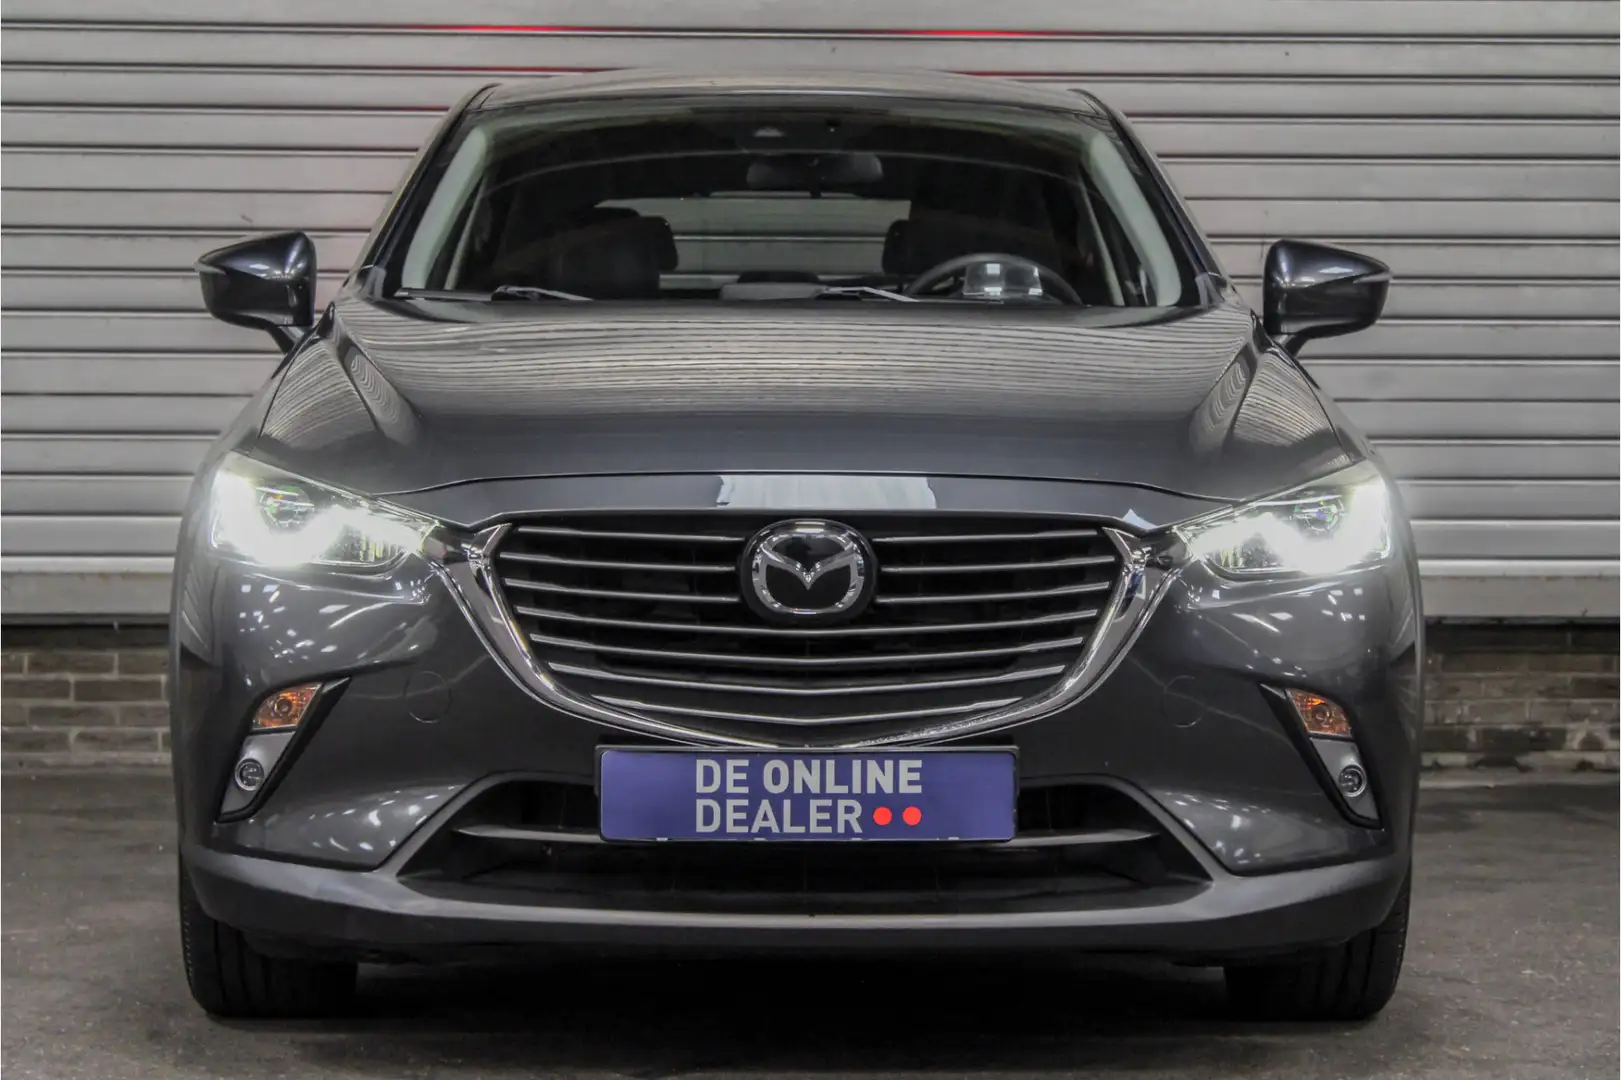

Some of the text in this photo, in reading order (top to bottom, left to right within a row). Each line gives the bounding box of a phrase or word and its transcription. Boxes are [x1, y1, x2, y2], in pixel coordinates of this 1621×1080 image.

[695, 759, 923, 794] DE ONLINE
[695, 799, 864, 833] DEALER
